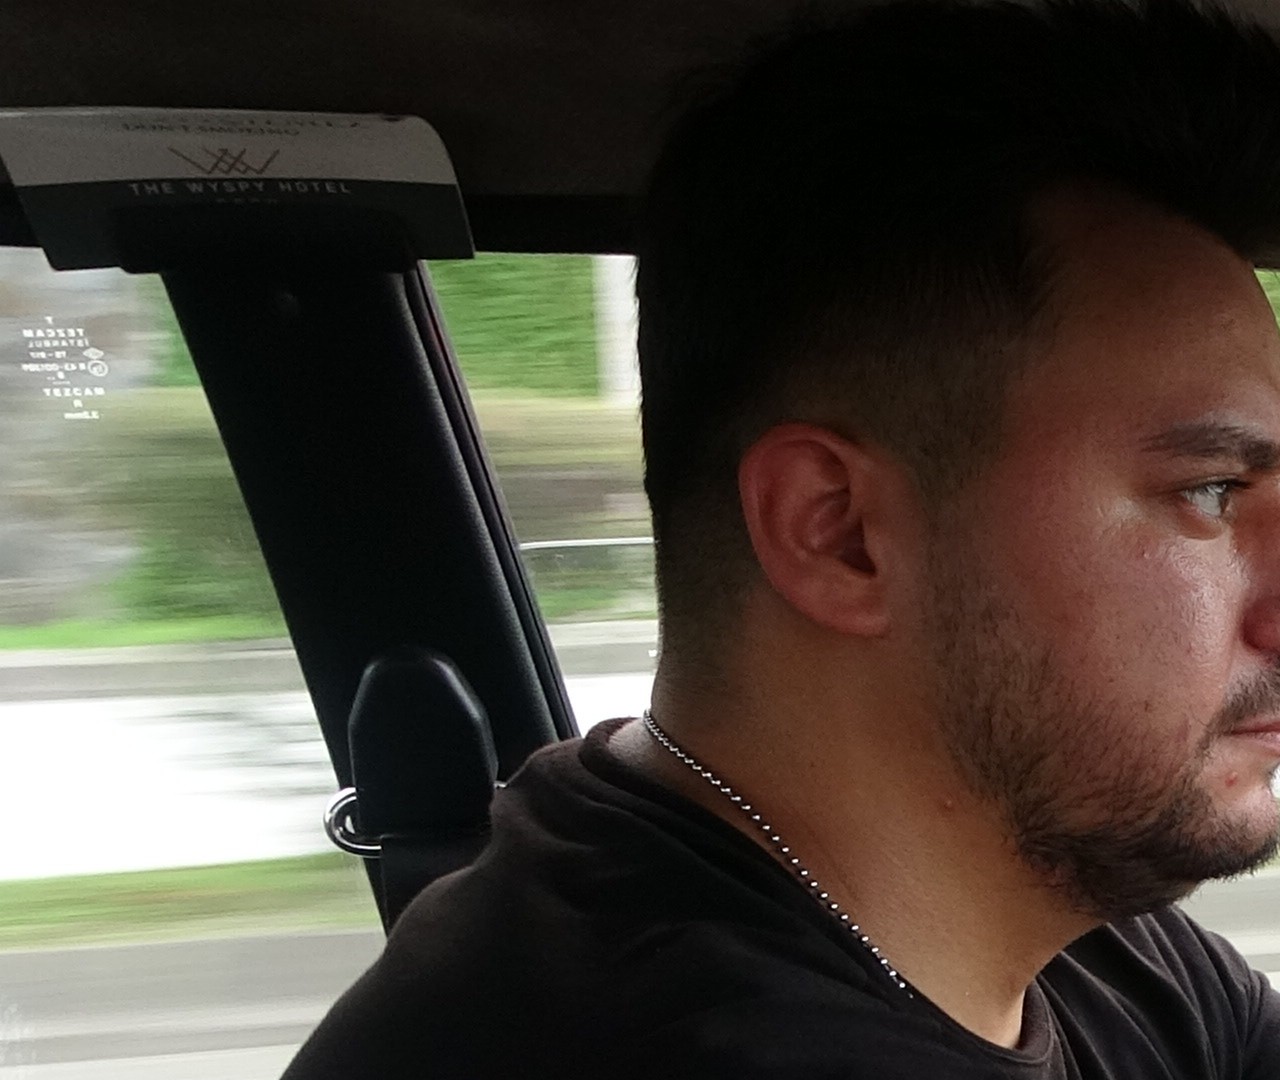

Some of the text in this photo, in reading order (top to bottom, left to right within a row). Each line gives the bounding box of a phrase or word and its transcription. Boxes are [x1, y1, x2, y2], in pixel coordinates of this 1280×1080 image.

[128, 180, 351, 197] THE WYSPY HOTEL
